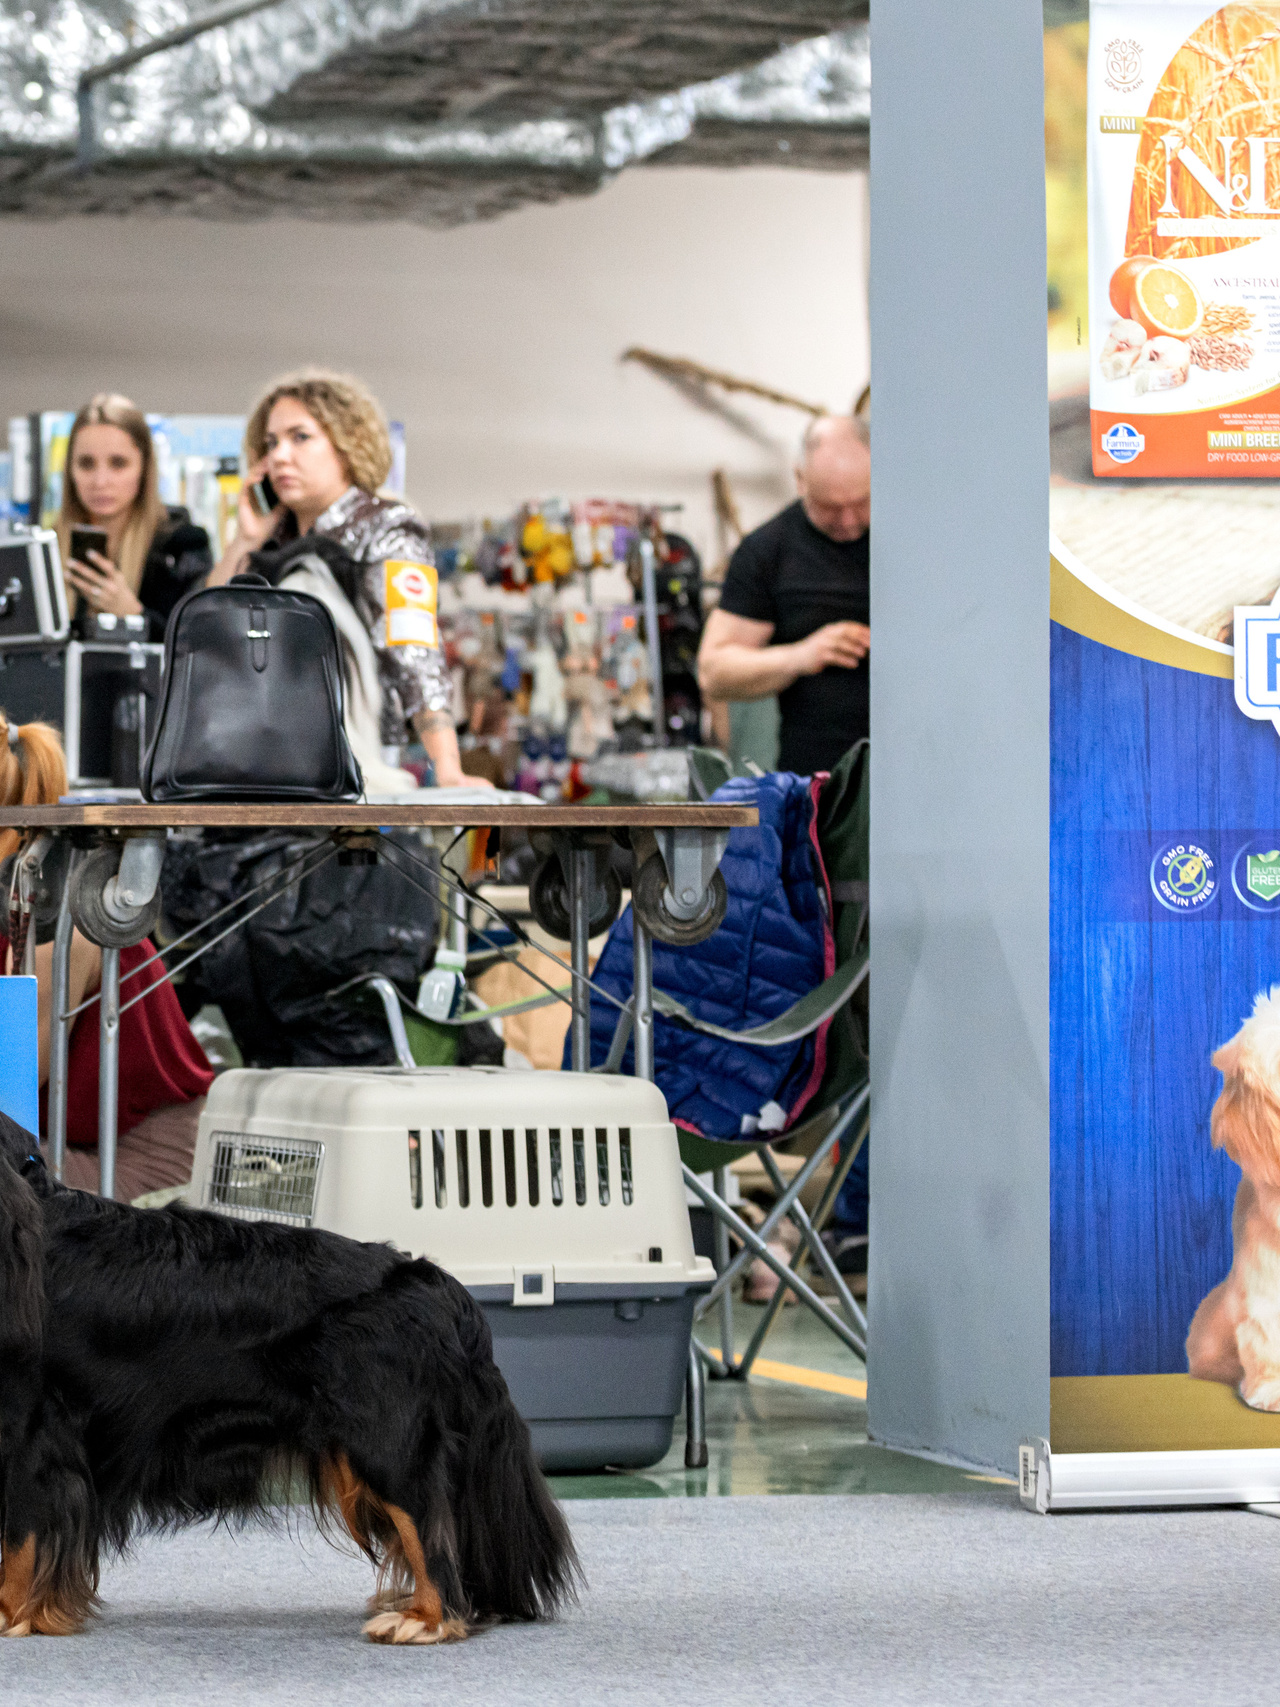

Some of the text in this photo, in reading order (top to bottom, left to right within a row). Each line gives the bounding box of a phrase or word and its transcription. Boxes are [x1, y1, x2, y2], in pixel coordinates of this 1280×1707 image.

[1103, 117, 1137, 131] MINI
[1106, 438, 1140, 448] Farmina
[1210, 432, 1242, 447] MINI
[1207, 452, 1225, 462] DRY
[1227, 452, 1249, 462] FOOD
[1162, 845, 1214, 869] GMO FREE
[1251, 875, 1280, 885] FREE
[1160, 880, 1215, 907] GRAIN FREE
